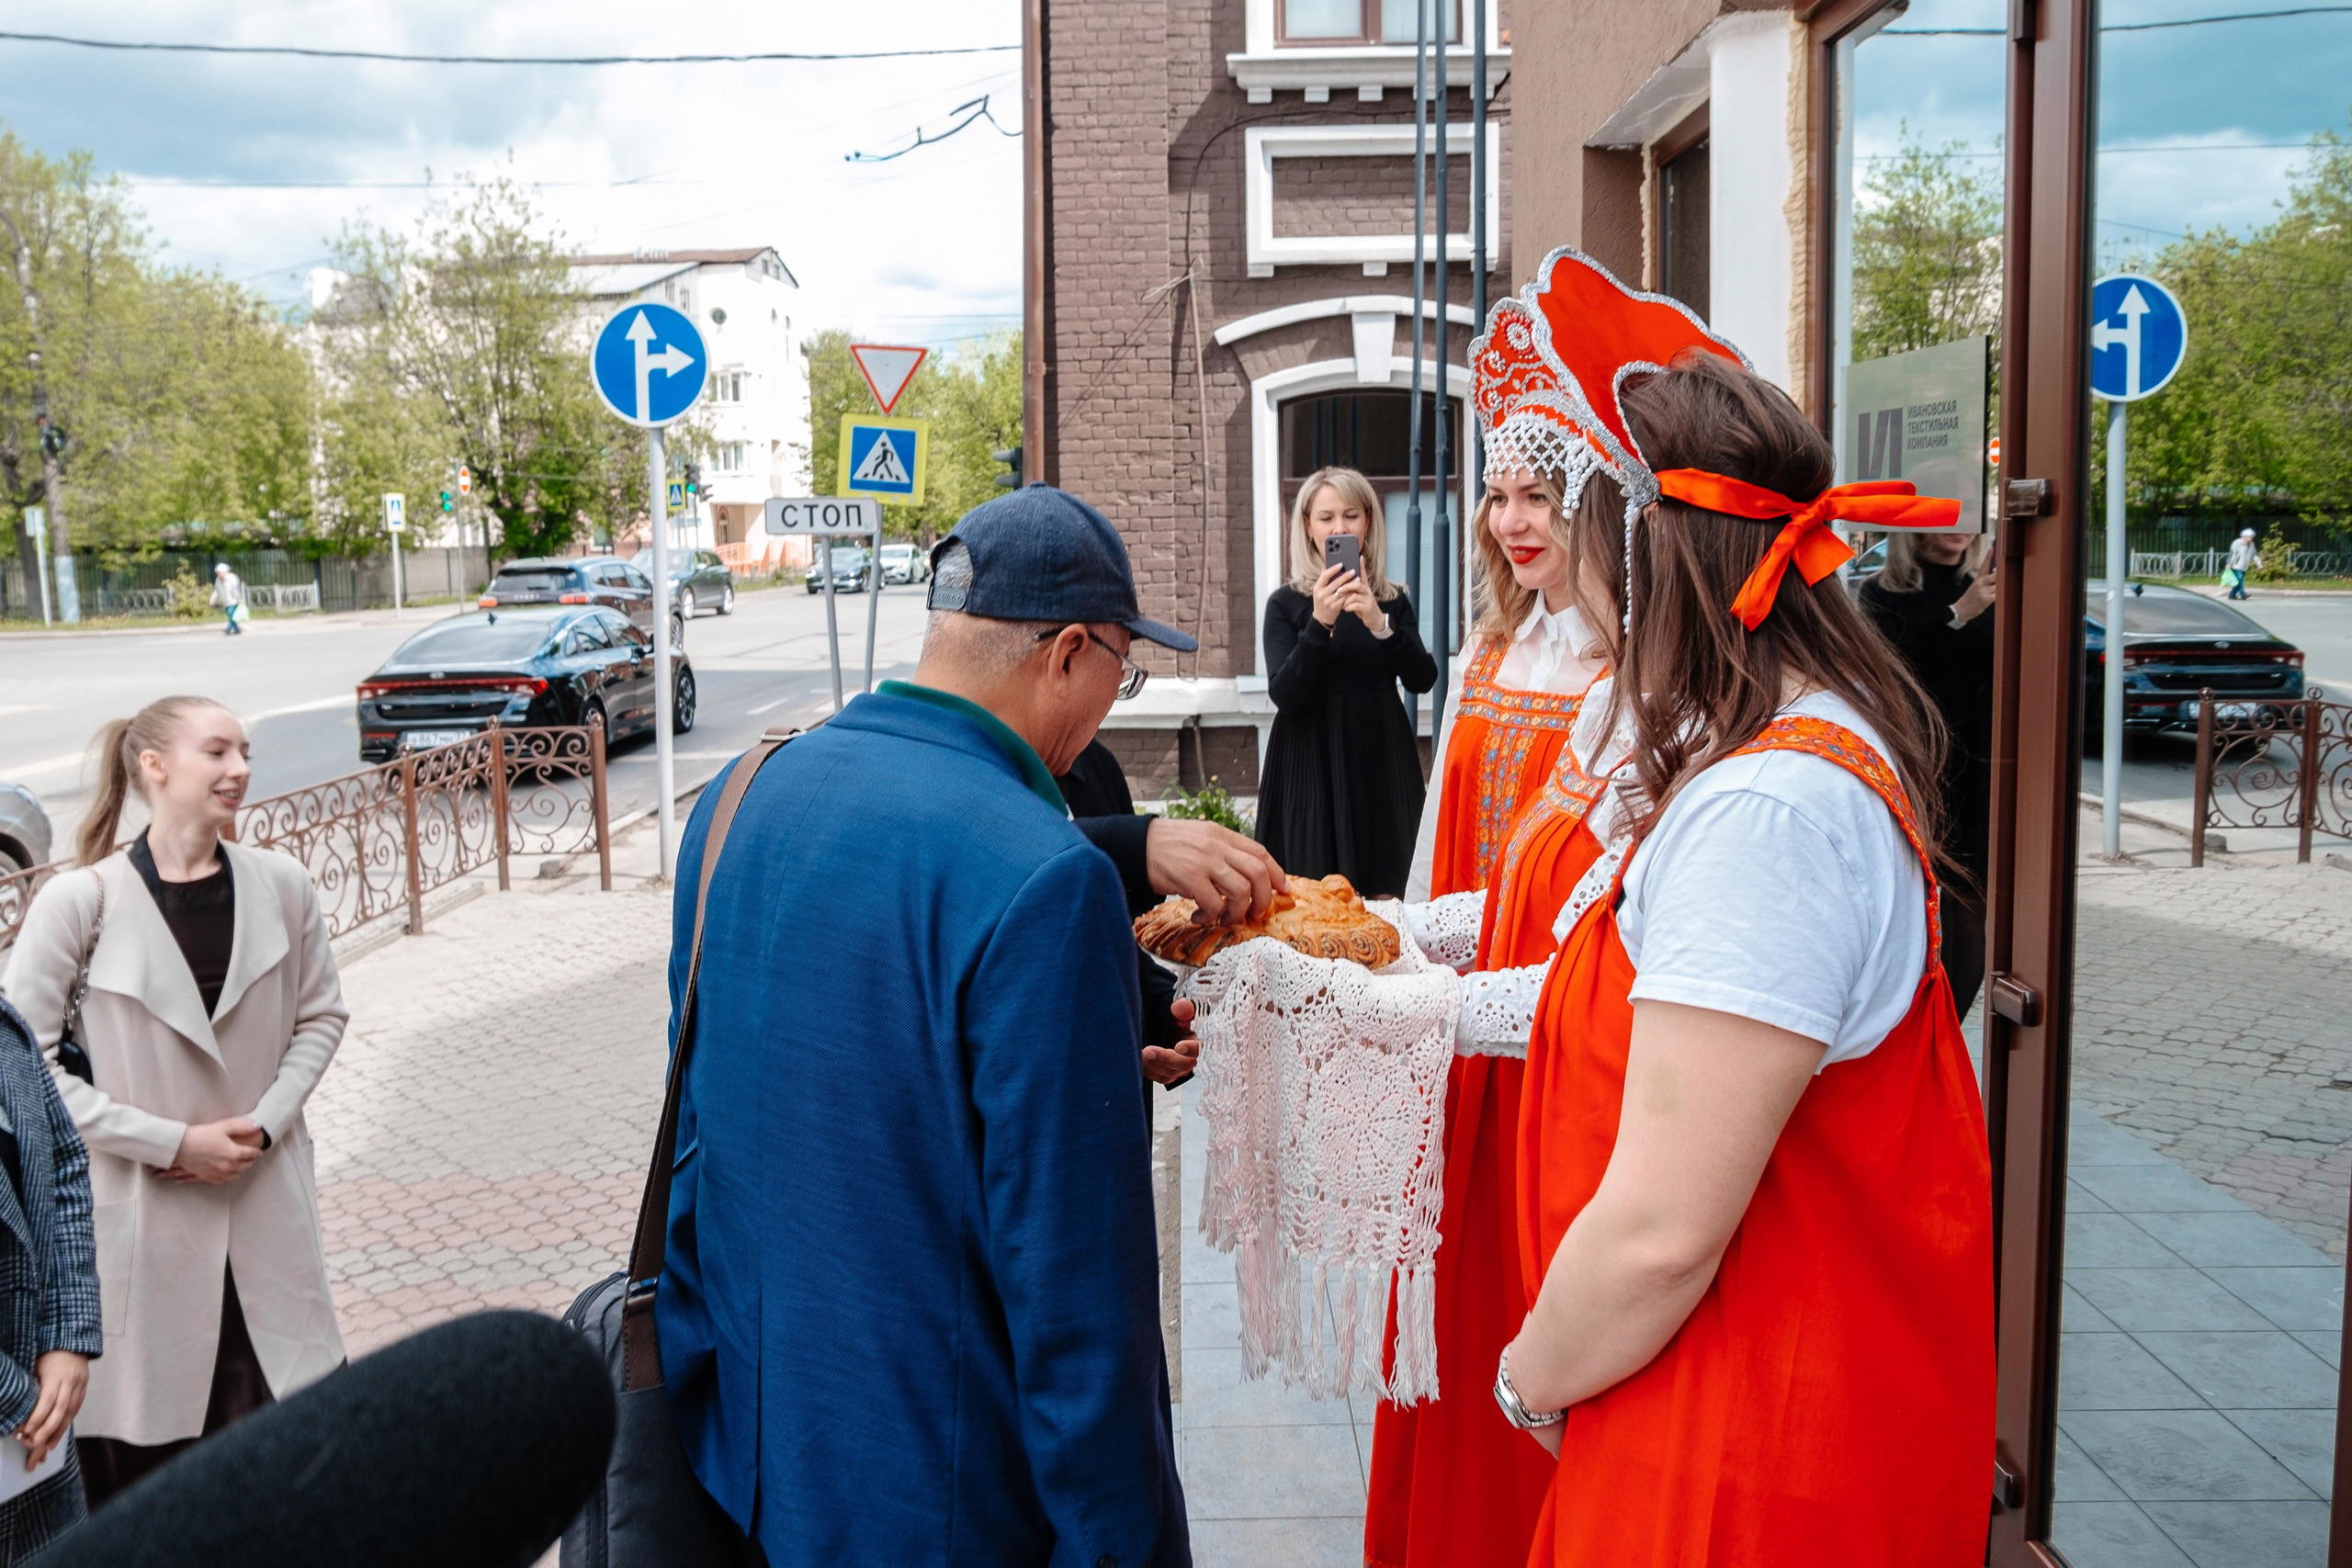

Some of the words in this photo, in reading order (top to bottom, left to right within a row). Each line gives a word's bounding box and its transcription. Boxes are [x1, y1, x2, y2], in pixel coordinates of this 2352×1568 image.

[1907, 400, 1956, 419] ИВАНОВСКАЯ
[1907, 416, 1959, 434] ТЕКСТИЛЬНАЯ
[1906, 434, 1948, 450] КОМПАНИЯ
[781, 504, 862, 527] СТОП
